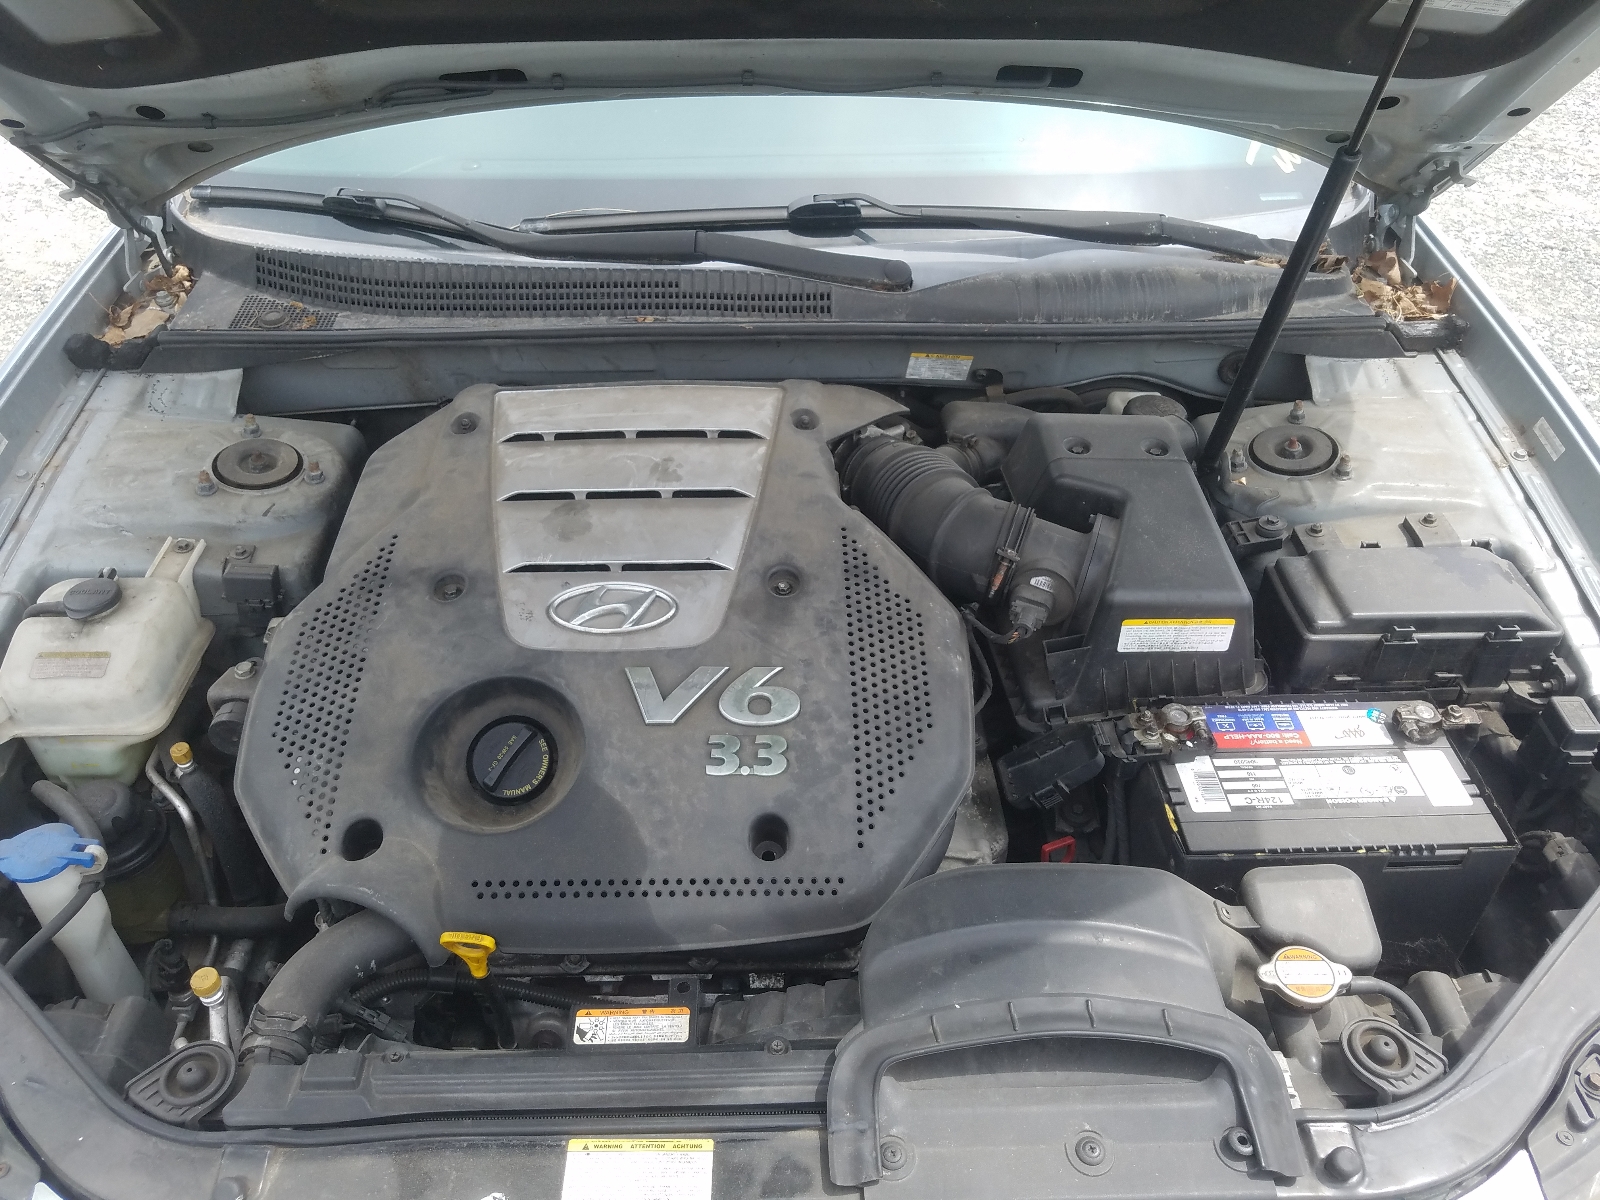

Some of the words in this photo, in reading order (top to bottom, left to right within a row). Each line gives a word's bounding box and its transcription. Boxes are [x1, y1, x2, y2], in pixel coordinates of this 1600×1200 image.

[624, 666, 801, 727] V6
[507, 734, 518, 746] SAE
[538, 738, 549, 752] SEE
[705, 734, 788, 776] 3.3
[531, 754, 549, 785] OWNER'S
[502, 783, 532, 797] MANUAL
[1243, 797, 1284, 805] 124R-C
